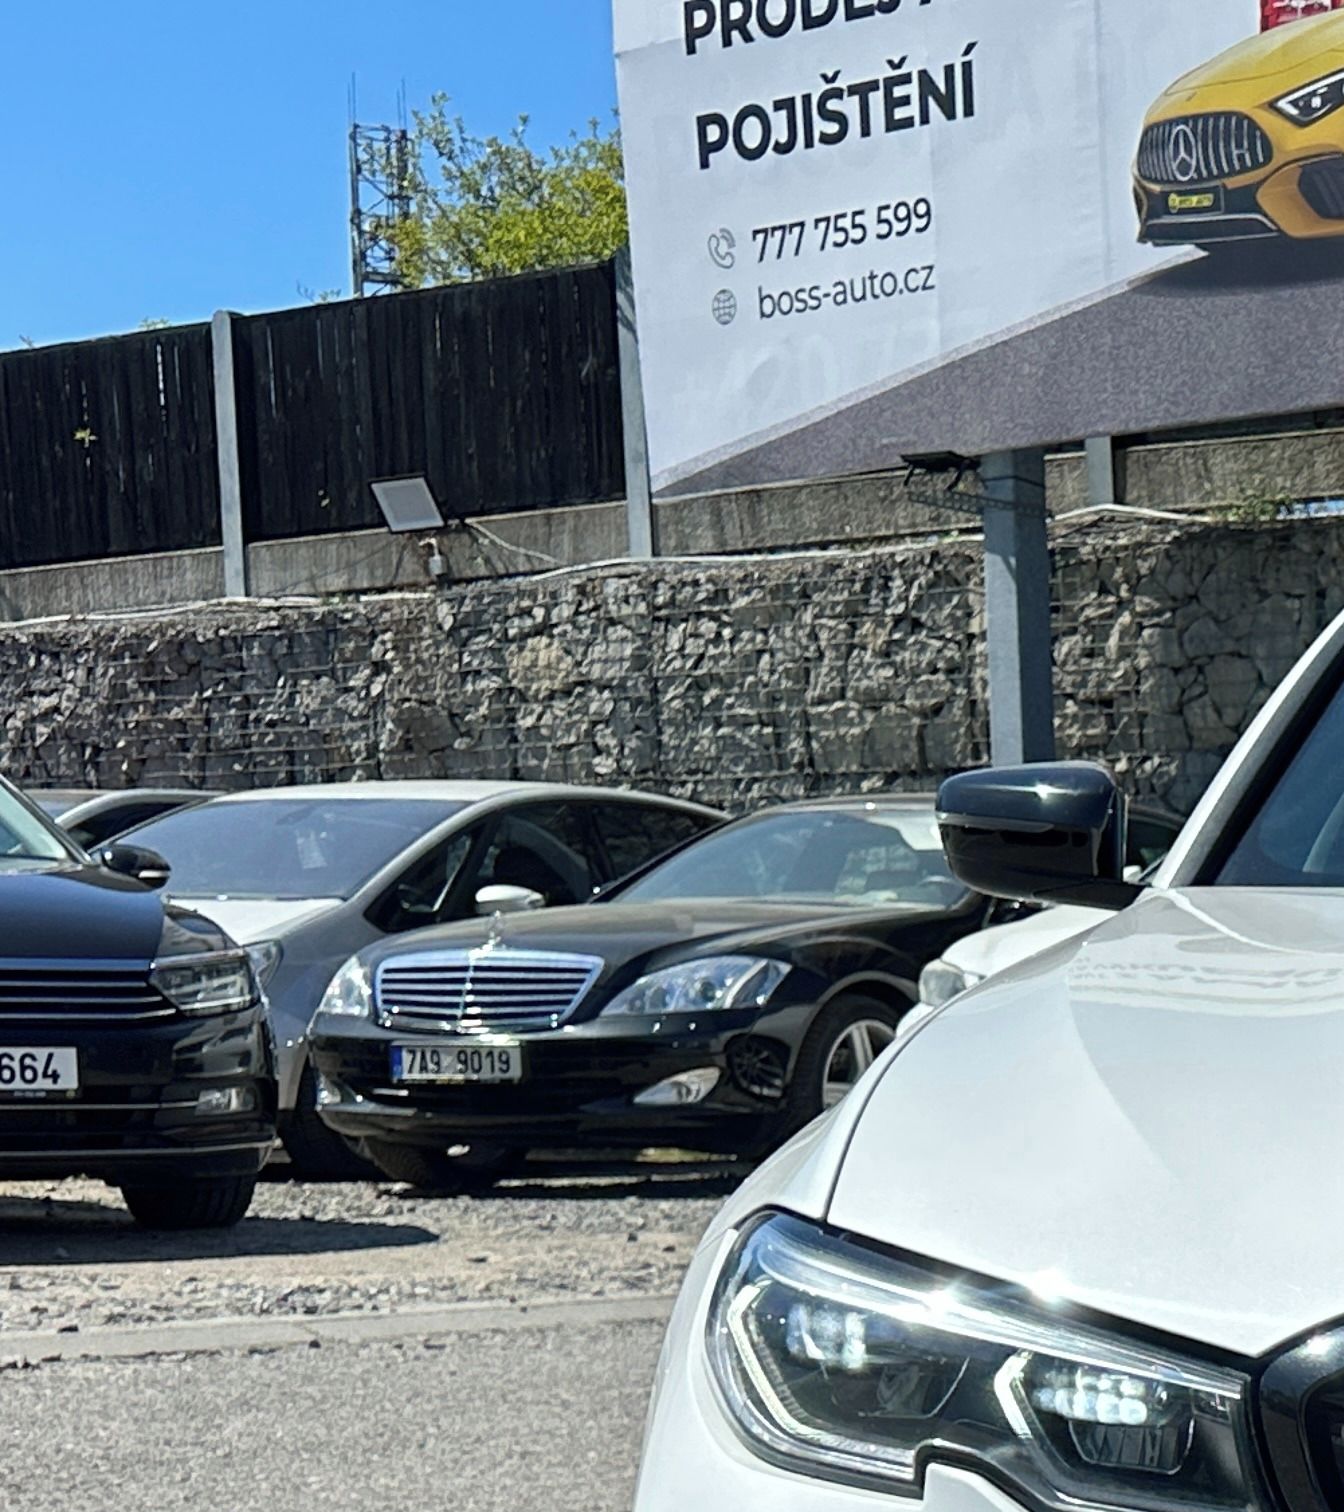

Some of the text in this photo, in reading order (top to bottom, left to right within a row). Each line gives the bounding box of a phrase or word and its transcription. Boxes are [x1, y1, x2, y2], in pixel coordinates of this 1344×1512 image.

[696, 41, 978, 169] POJIŠTĚNÍ
[752, 197, 932, 263] 777 755 599
[758, 264, 936, 320] boss-auto.cz
[406, 1049, 511, 1074] 7A9 9019
